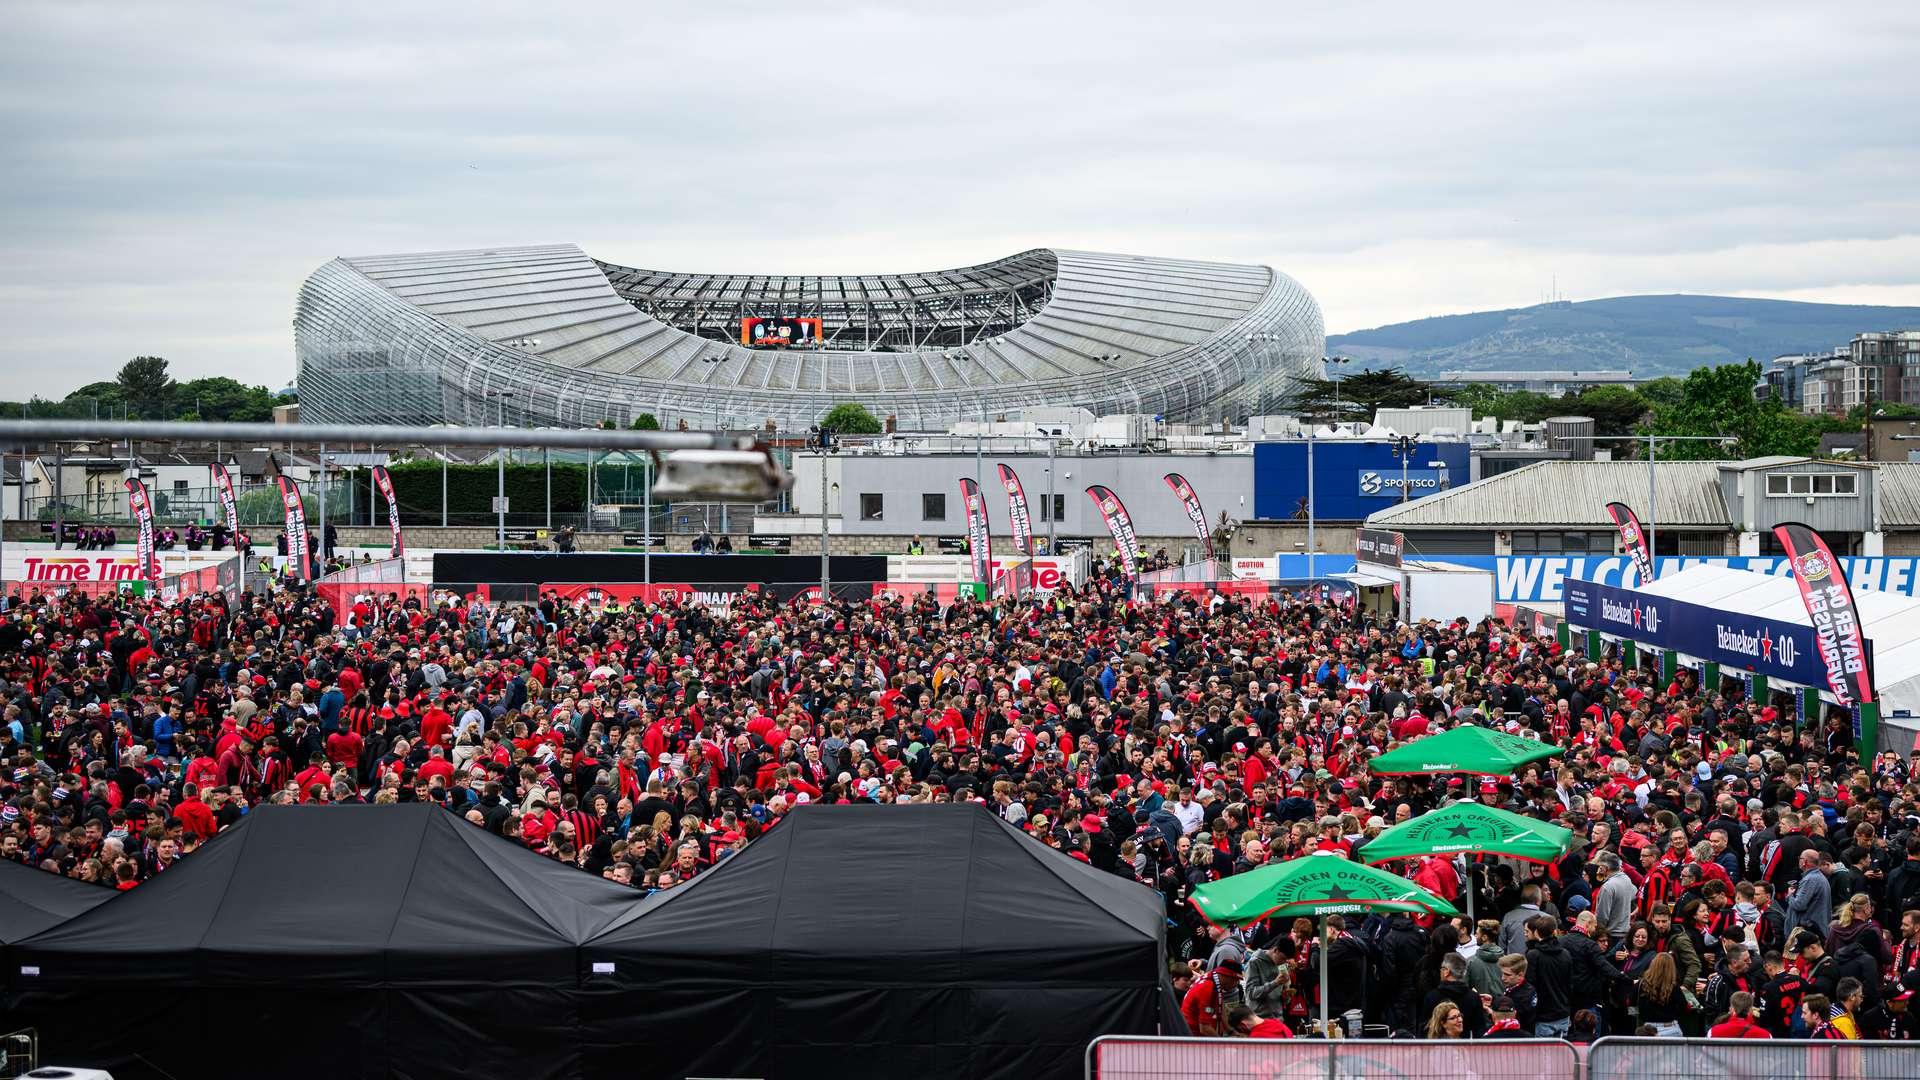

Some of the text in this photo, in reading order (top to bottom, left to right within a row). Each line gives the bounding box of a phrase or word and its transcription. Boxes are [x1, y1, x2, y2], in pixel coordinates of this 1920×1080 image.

[24, 558, 91, 581] Time
[1497, 557, 1728, 600] WELCOM
[1602, 598, 1657, 633] Heineken 0.0
[1717, 624, 1795, 667] Heineken 0.0
[193, 699, 209, 718] 34
[1405, 814, 1516, 839] HEINEKEN ORIGINAL
[1276, 871, 1395, 904] HEINEKEN ORIGINA
